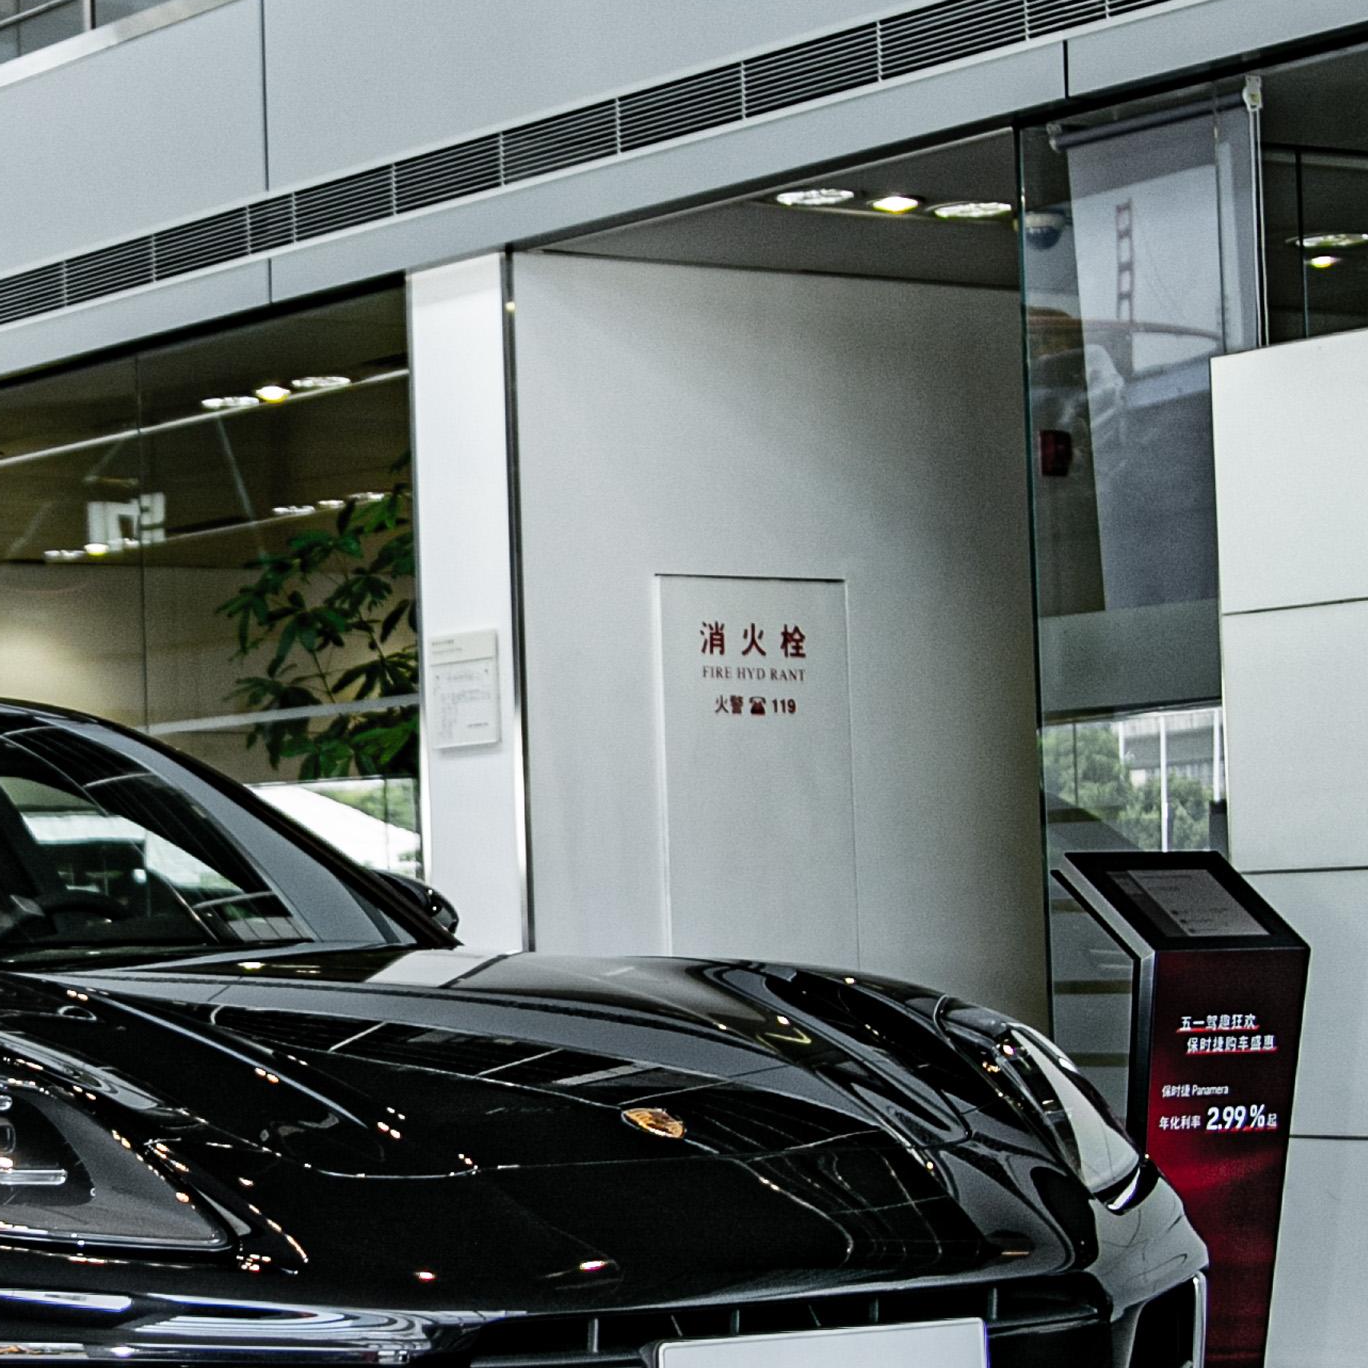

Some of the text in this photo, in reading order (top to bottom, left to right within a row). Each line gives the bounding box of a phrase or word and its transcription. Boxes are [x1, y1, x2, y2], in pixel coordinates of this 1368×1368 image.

[699, 620, 807, 659] 消火栓
[702, 666, 732, 680] FIRE
[715, 694, 797, 715] 火警 119
[1192, 1084, 1229, 1096] Panamera
[1159, 1115, 1201, 1131] 年化利率
